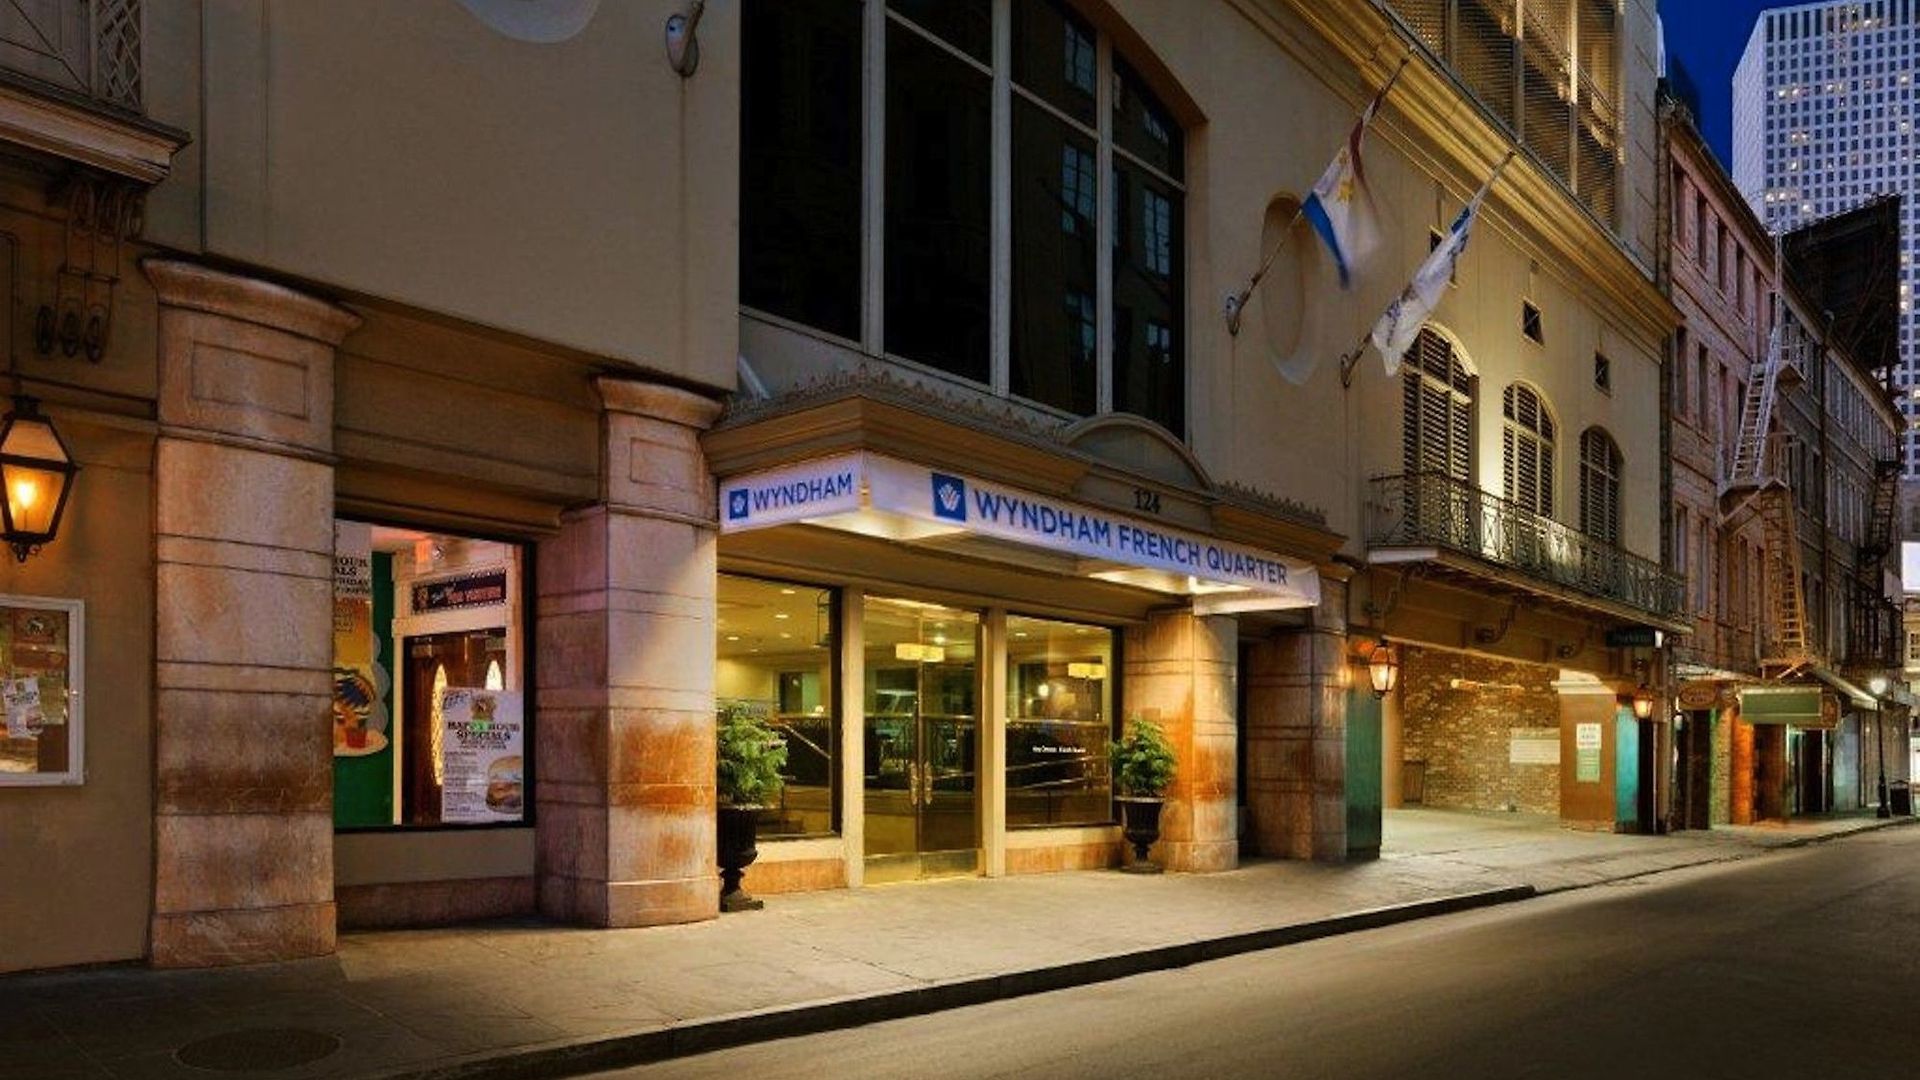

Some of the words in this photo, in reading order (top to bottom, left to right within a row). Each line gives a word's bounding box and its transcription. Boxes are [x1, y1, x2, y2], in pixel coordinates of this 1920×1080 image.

[753, 473, 853, 511] WYNDHAM
[1133, 485, 1161, 514] 124
[974, 489, 1112, 548] WYNDHAM
[1118, 524, 1201, 568] FRENCH
[1206, 546, 1288, 586] QUARTER
